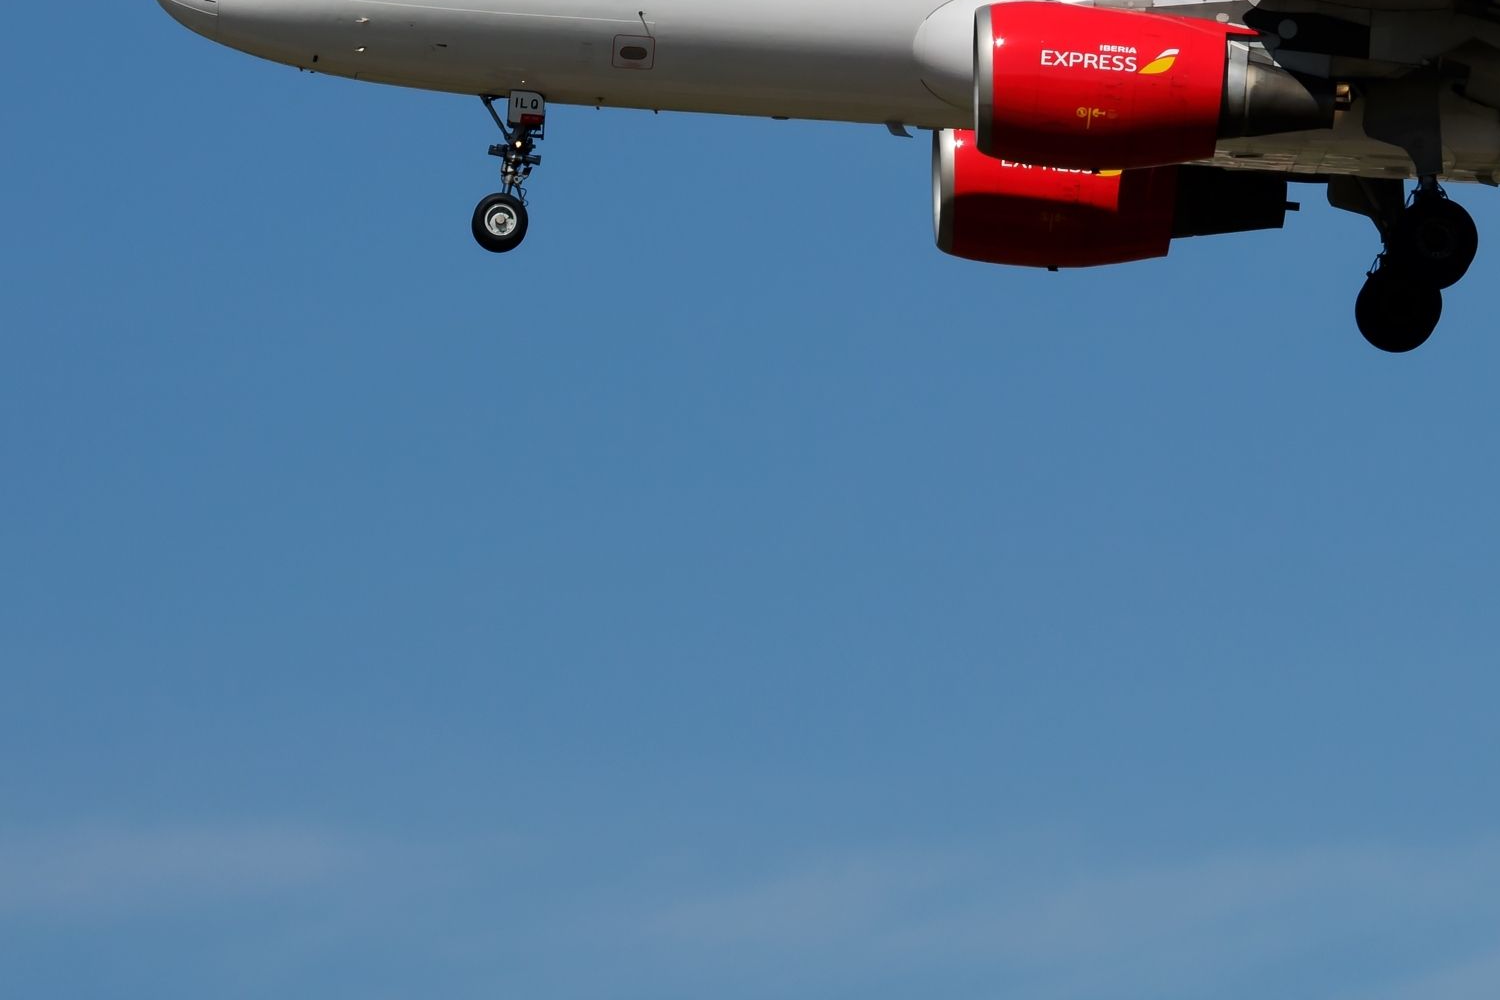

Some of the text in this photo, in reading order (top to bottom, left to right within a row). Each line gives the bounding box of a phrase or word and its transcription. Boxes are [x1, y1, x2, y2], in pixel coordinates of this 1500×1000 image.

[1100, 44, 1137, 54] IBERIA
[1040, 49, 1137, 72] EXPRESS
[514, 97, 539, 110] ILQ
